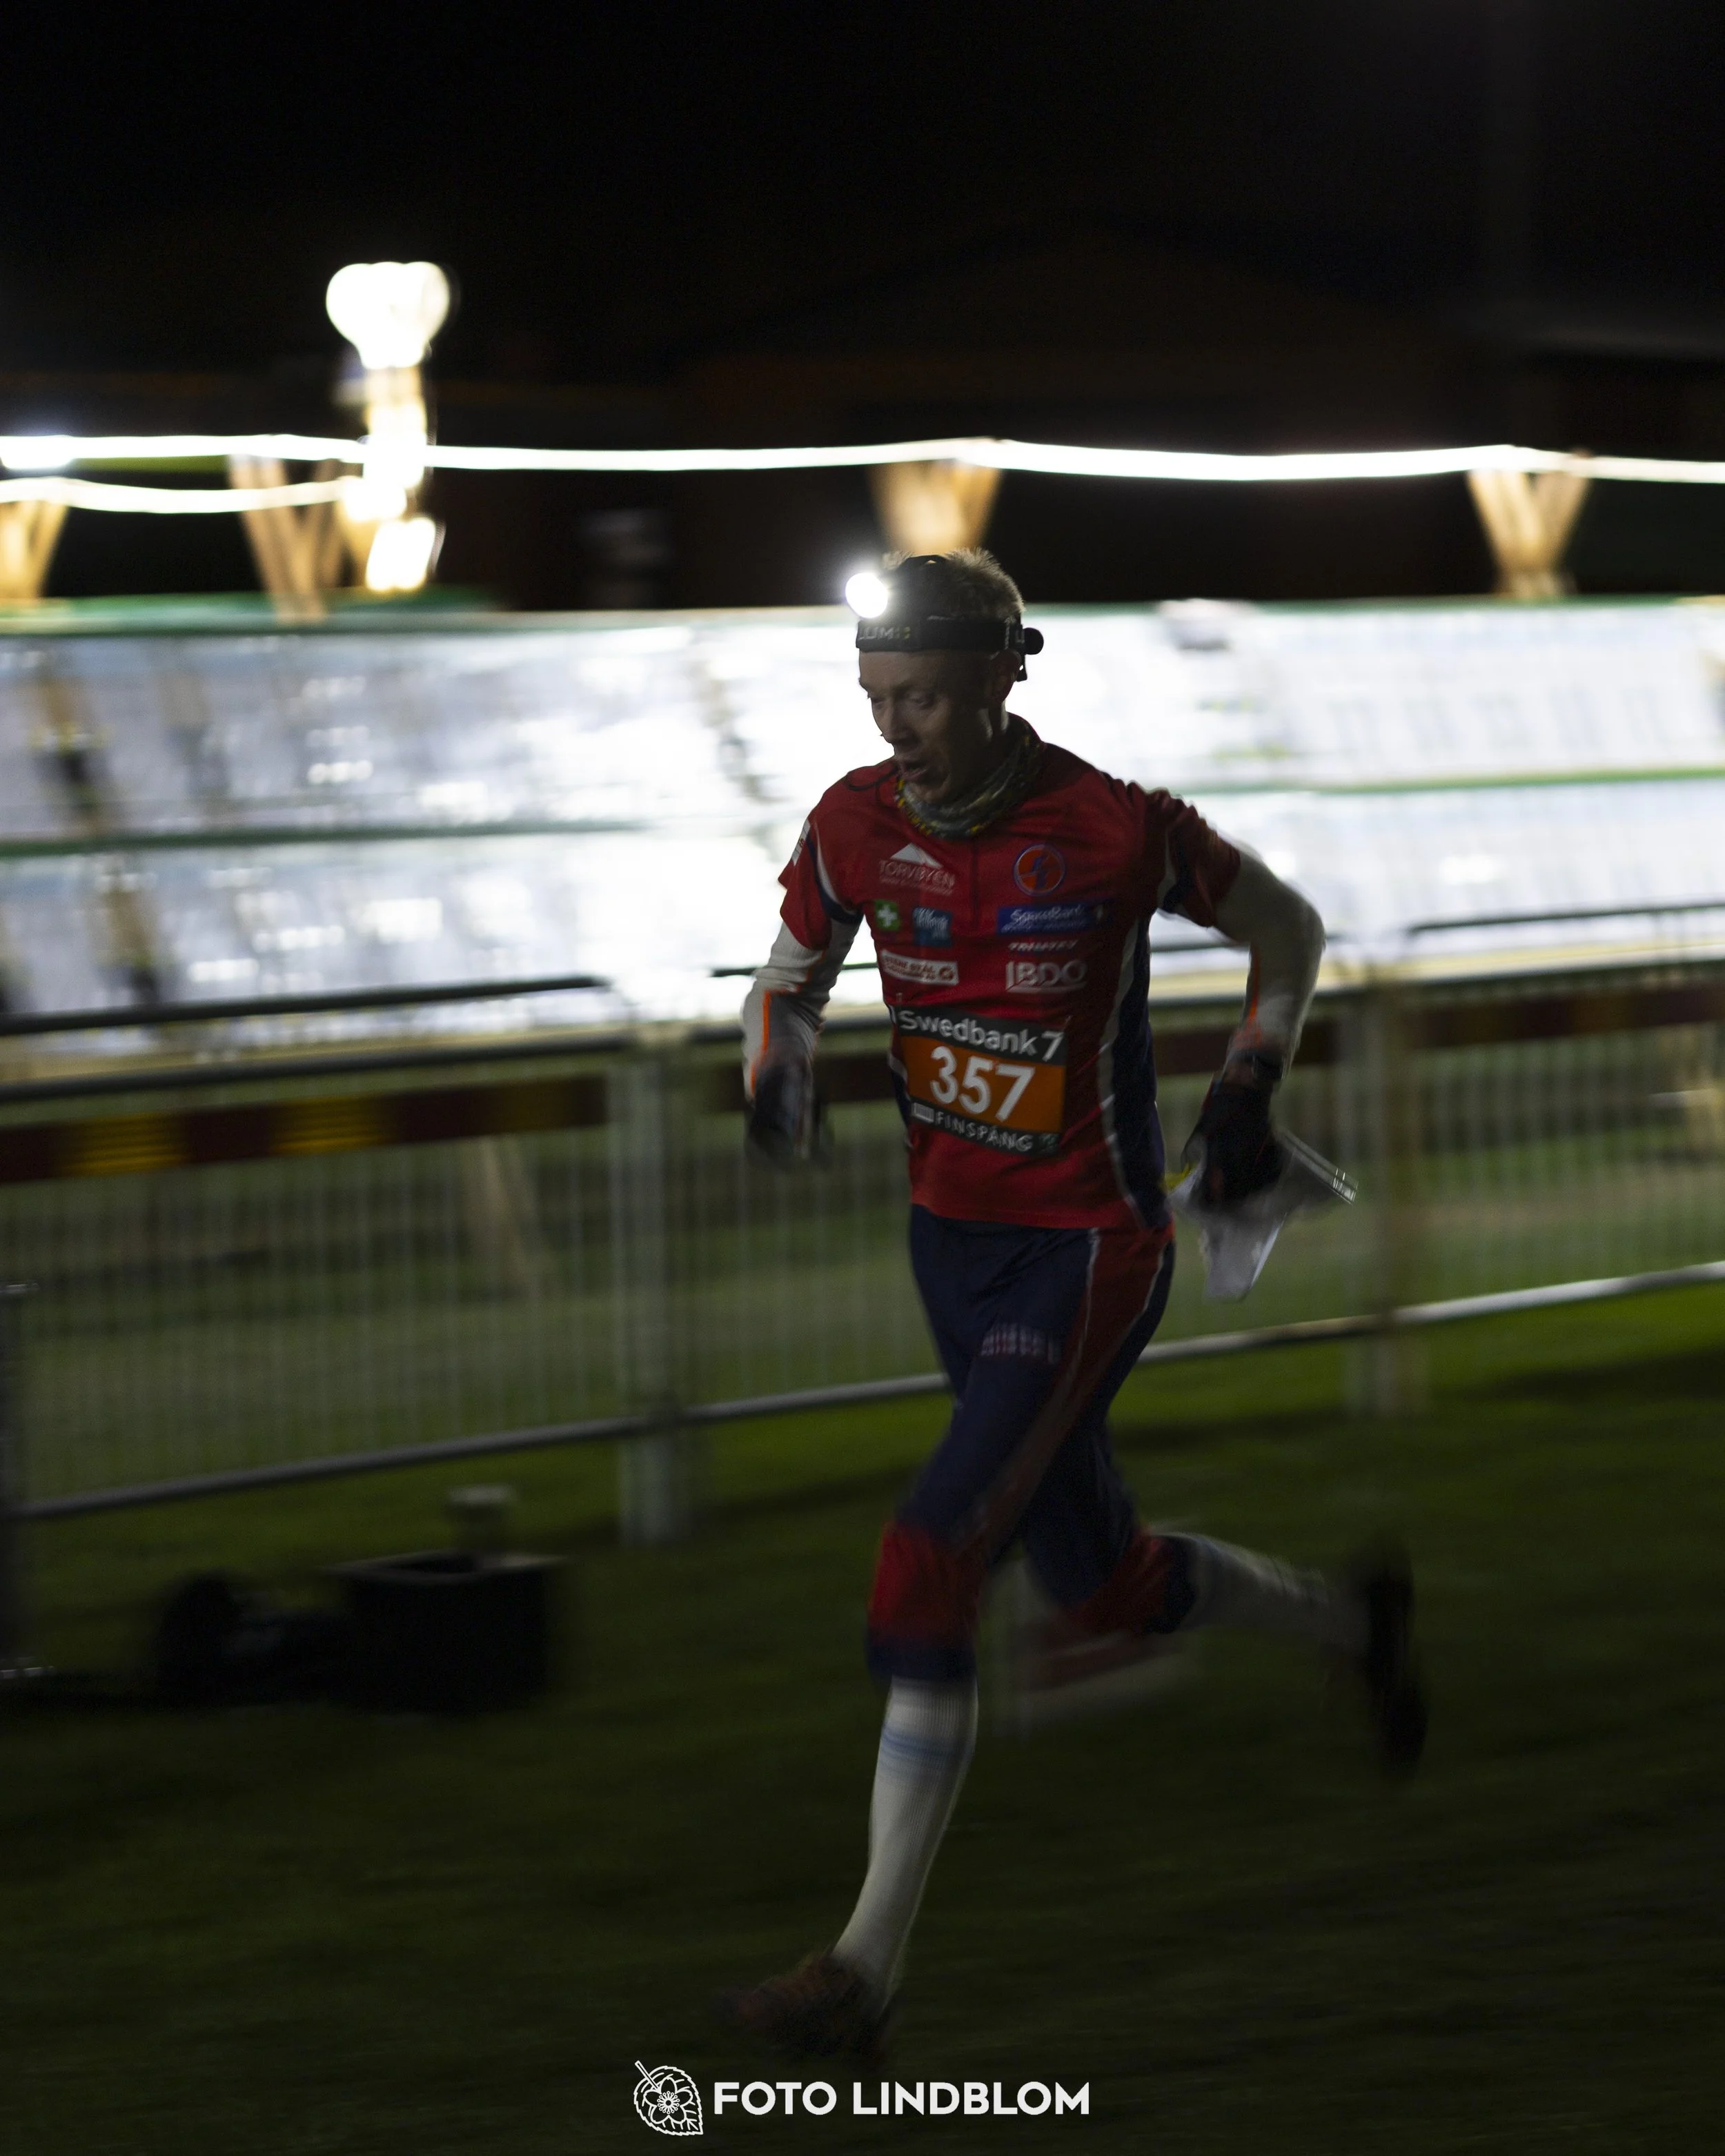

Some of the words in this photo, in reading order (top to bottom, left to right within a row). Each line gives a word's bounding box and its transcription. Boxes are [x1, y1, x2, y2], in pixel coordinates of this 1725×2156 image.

[1016, 960, 1088, 987] BDO
[898, 1010, 1038, 1056] Swedbank
[1041, 1030, 1064, 1062] 7
[930, 1046, 1036, 1122] 357
[935, 1110, 1034, 1152] FINSPÅNG
